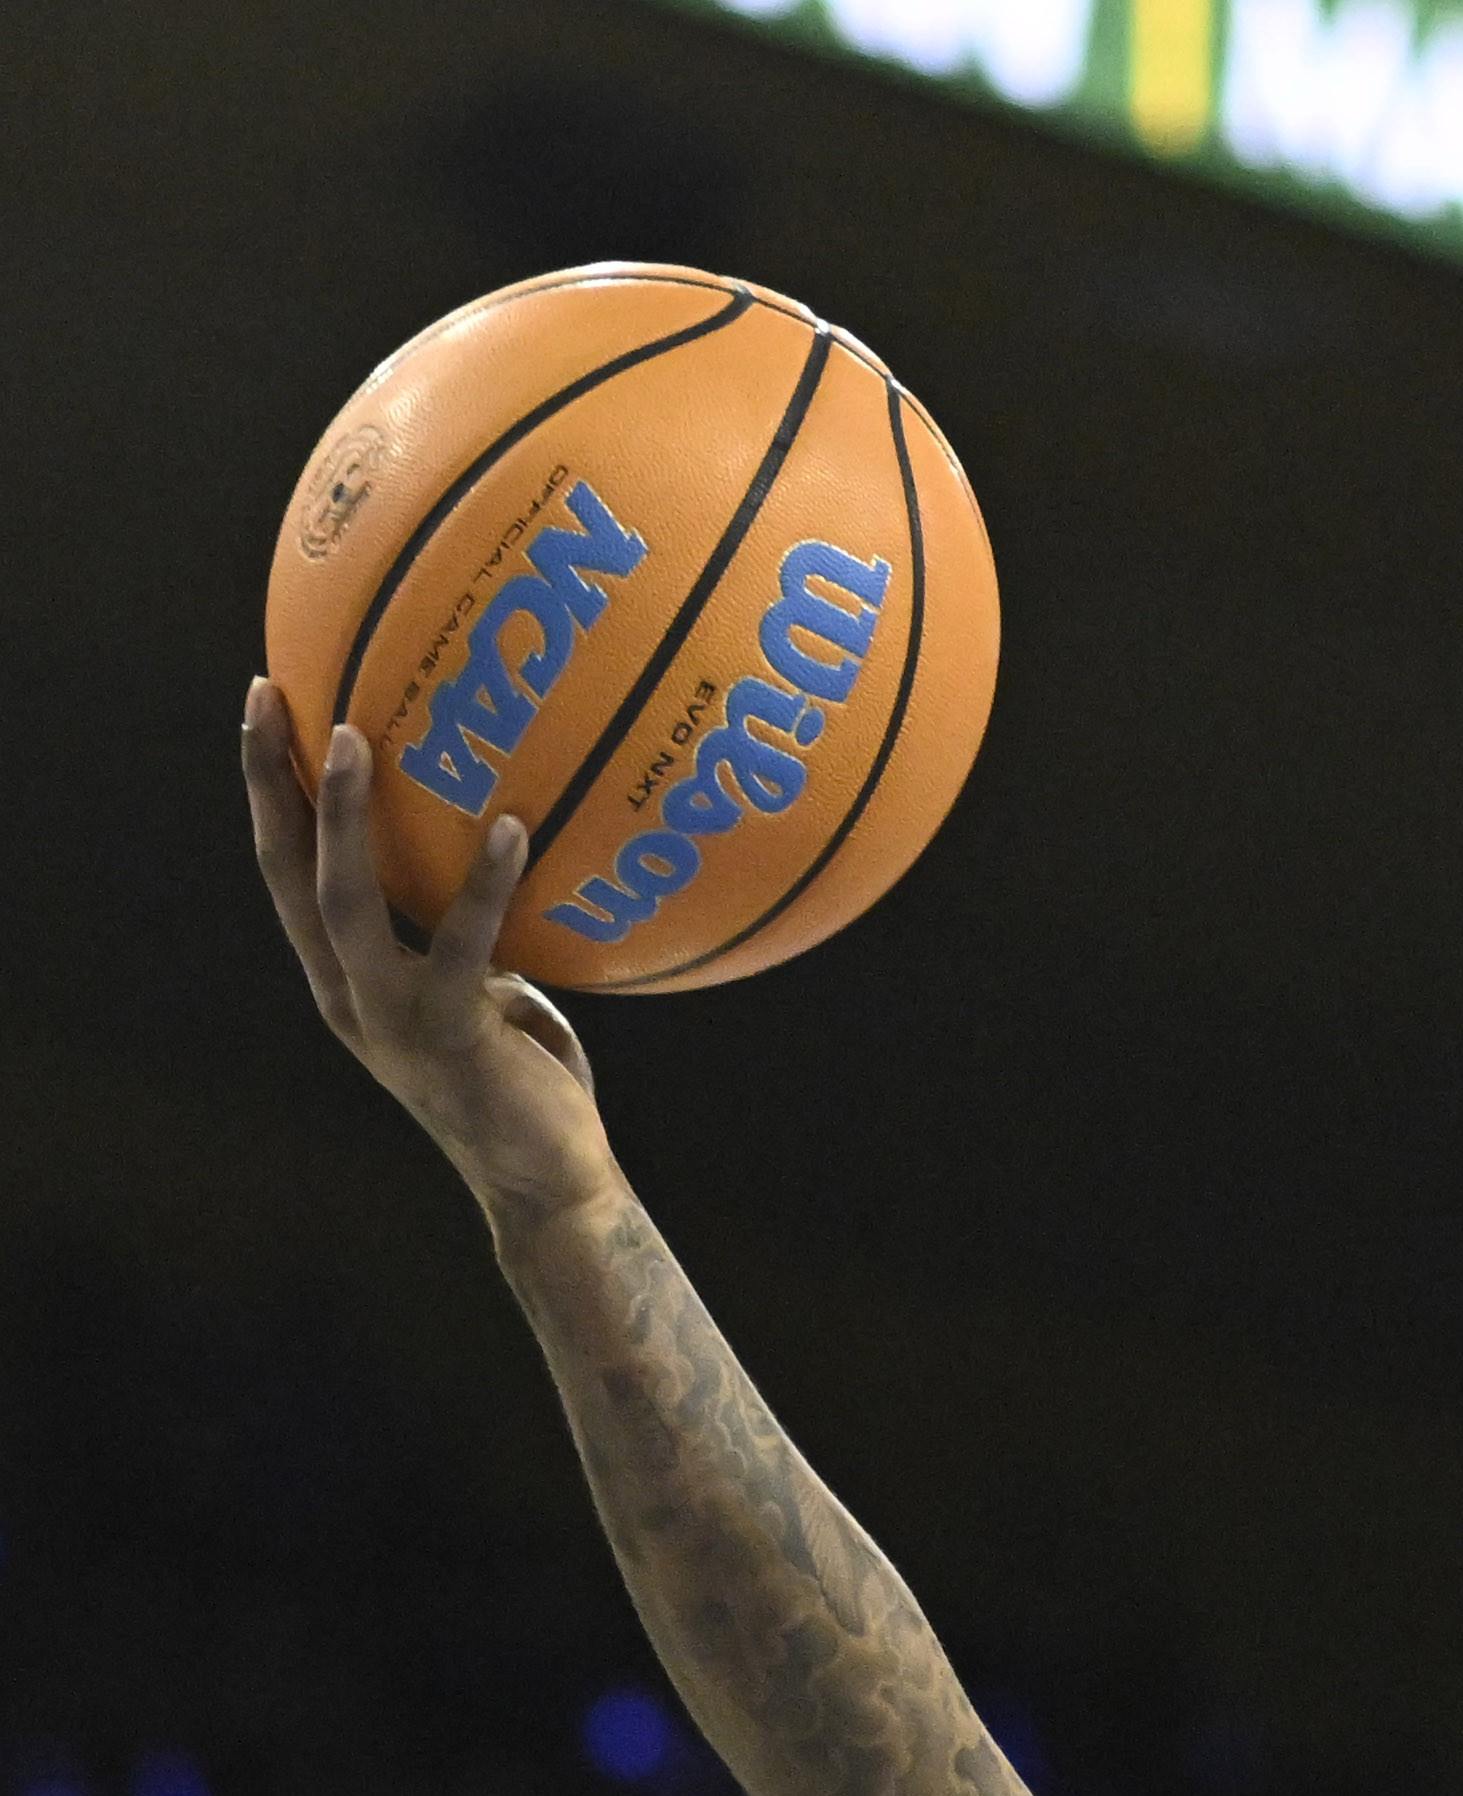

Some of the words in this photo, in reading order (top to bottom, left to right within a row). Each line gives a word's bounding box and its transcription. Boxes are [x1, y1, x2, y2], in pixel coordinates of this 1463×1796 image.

[474, 465, 568, 583] OFFICIAL
[399, 481, 649, 818] NCAA
[420, 594, 475, 677] GAME
[543, 539, 892, 942] Wilson
[672, 681, 716, 745] EVO
[627, 752, 674, 812] NXT
